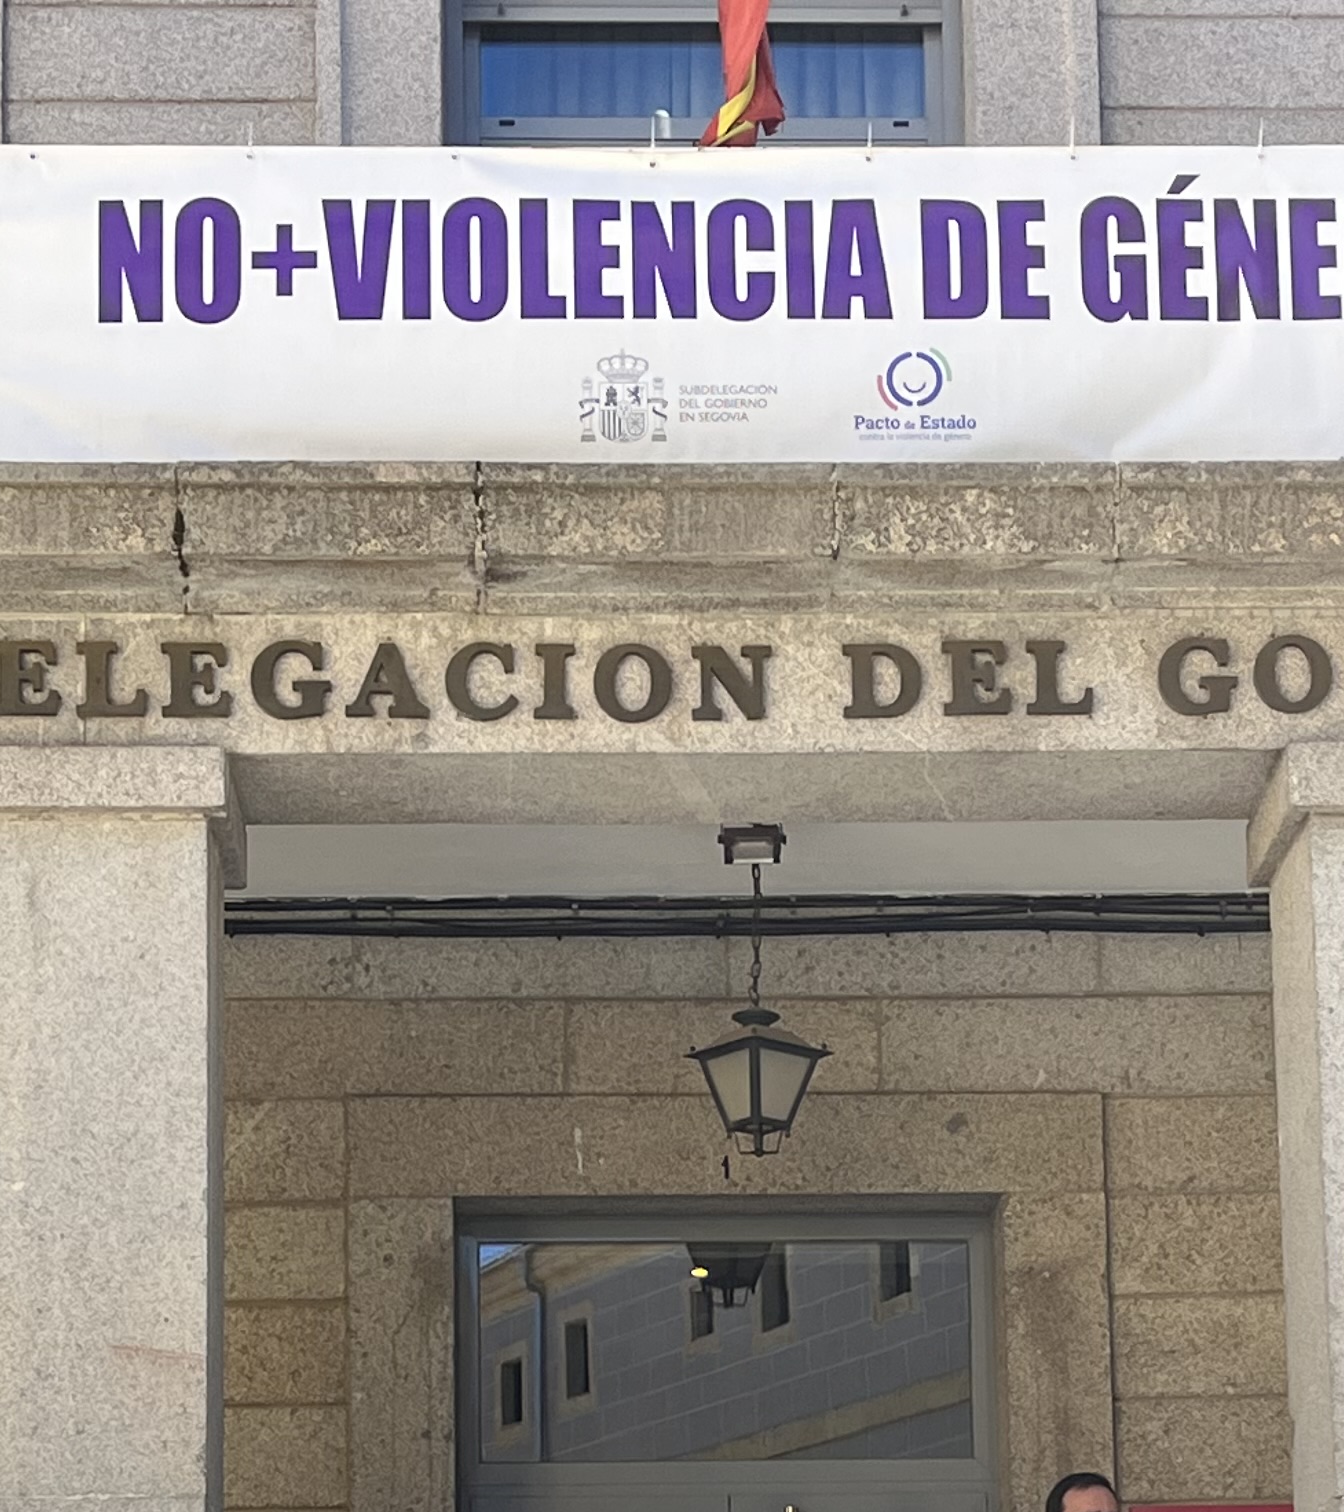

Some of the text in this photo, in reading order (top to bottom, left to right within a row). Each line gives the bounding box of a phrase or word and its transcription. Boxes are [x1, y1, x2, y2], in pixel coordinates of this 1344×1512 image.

[920, 198, 1051, 321] DE
[679, 398, 768, 409] DEL GOBIERNO
[679, 412, 749, 423] EN SEGOVIA
[854, 415, 900, 429] Pacto
[920, 414, 977, 429] Estado
[841, 640, 1096, 720] DEL
